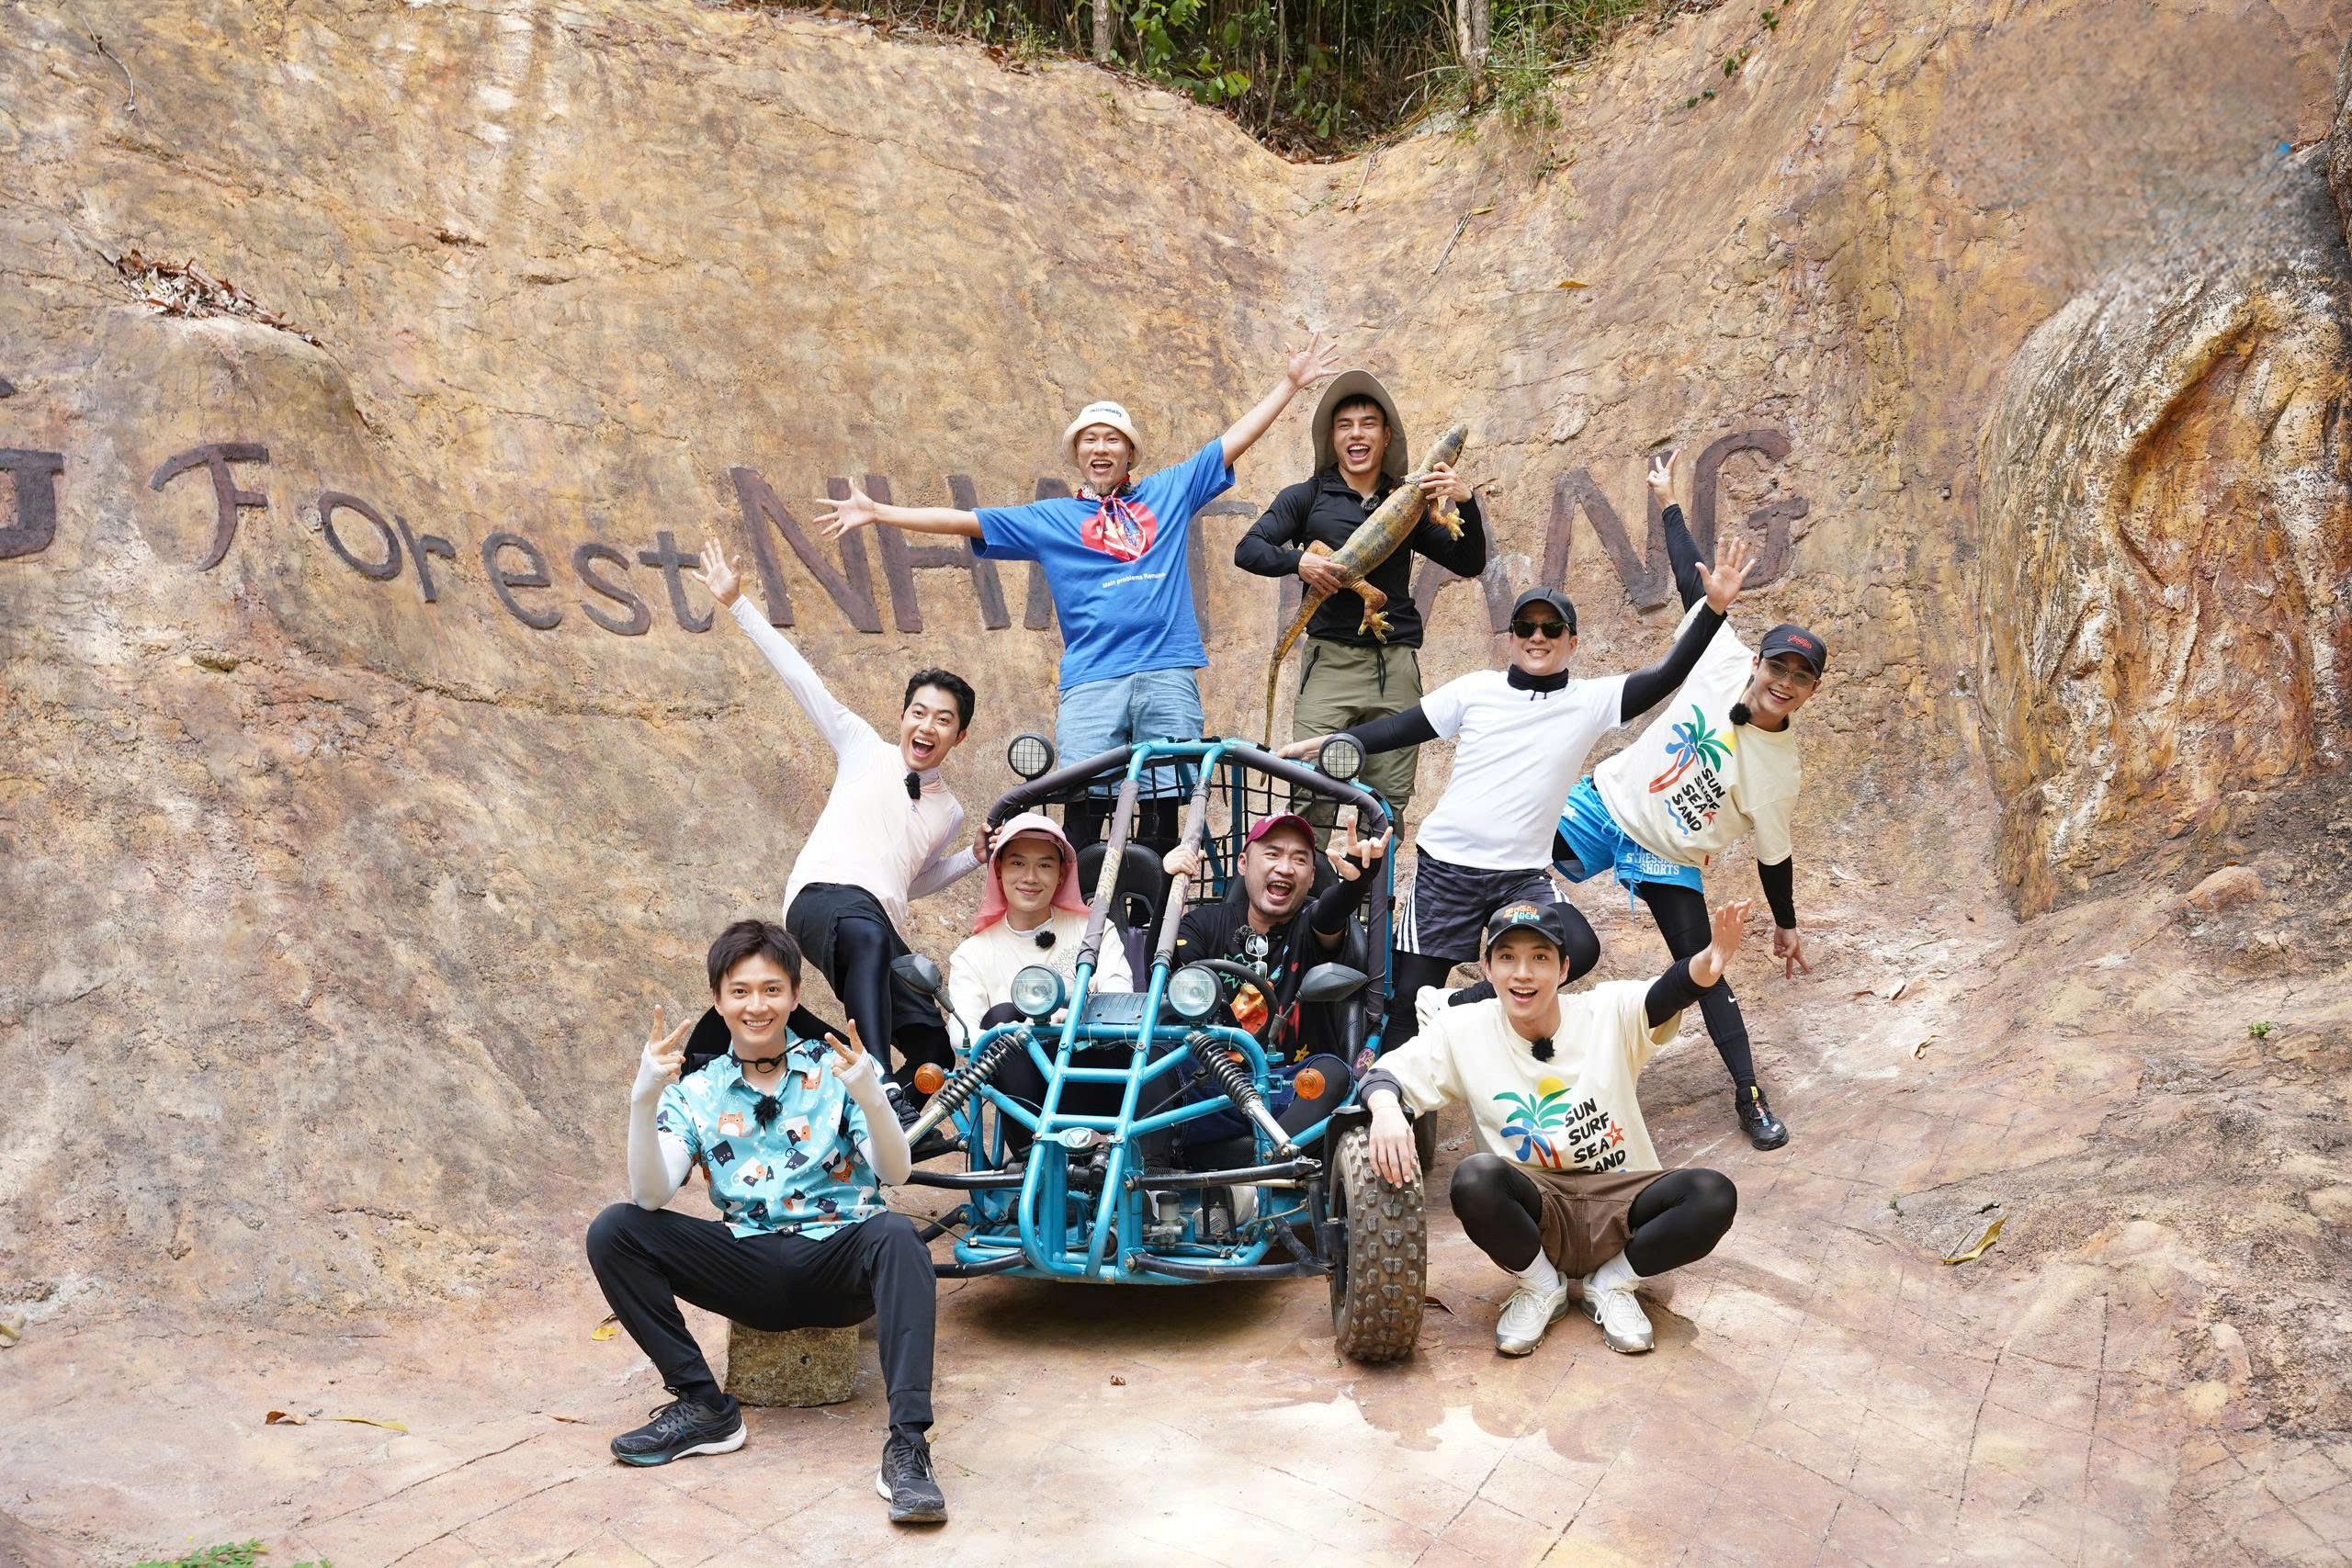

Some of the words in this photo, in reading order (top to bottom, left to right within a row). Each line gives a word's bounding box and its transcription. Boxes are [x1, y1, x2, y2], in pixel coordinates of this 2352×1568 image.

[150, 443, 715, 636] Forest
[1187, 428, 1810, 647] TANG
[1681, 784, 1708, 814] SEA
[1702, 768, 1726, 799] SUN
[1671, 793, 1702, 831] SAND
[1639, 863, 1680, 875] SHORTS
[1565, 1097, 1598, 1128] SUN
[1567, 1111, 1610, 1146] SURF
[1573, 1137, 1611, 1164] SEA
